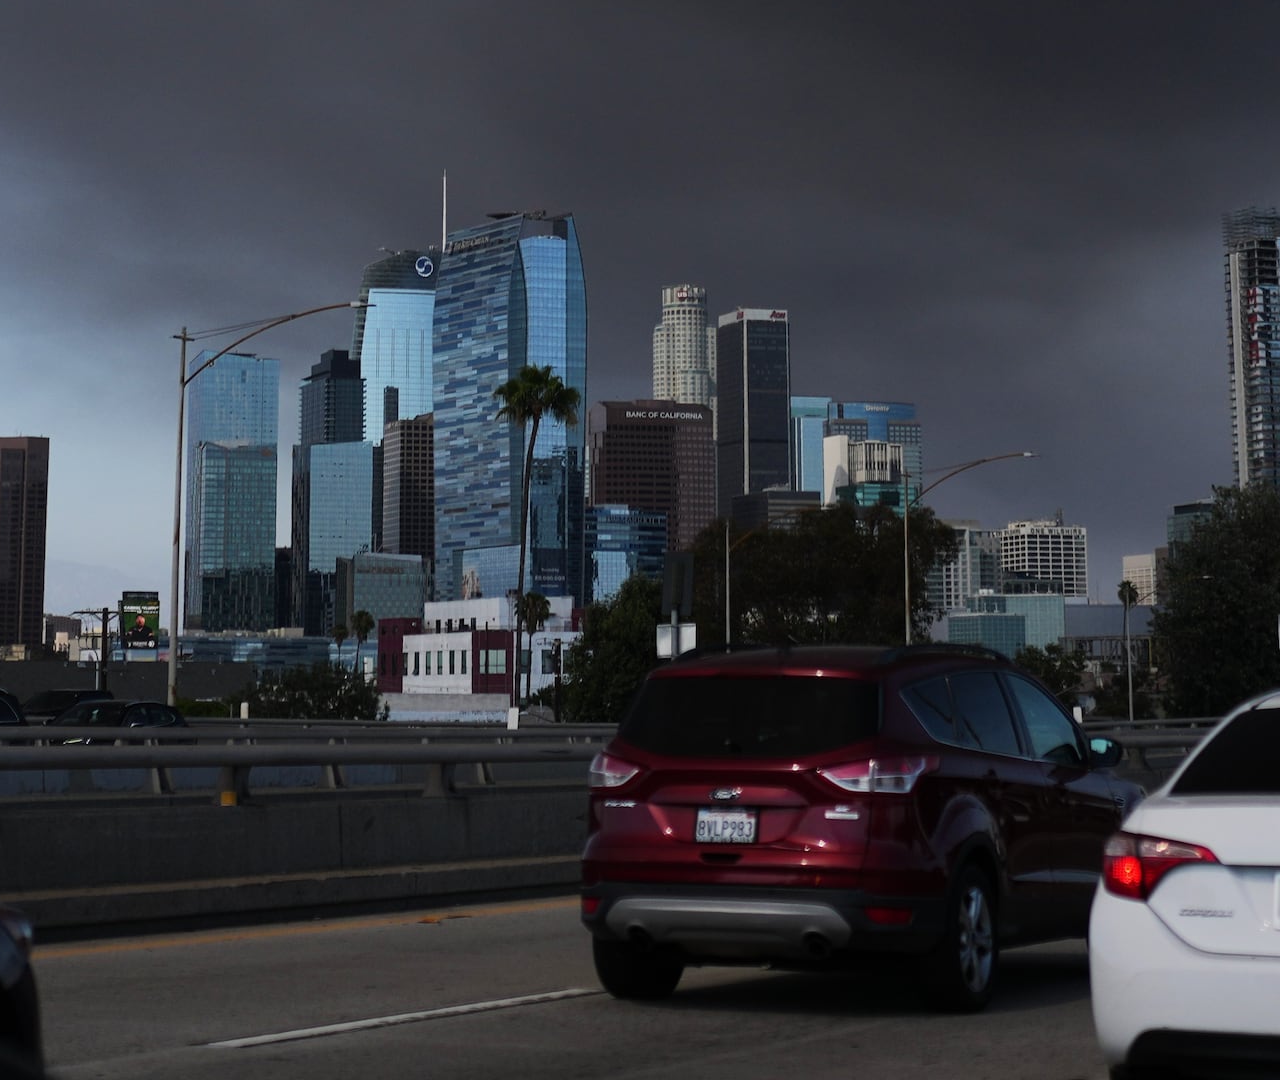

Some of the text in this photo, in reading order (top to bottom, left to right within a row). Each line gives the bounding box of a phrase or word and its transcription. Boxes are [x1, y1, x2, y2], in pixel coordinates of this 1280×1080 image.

[625, 411, 647, 419] BANC
[648, 411, 659, 419] OF
[1048, 528, 1082, 536] WILSHIRE
[697, 820, 753, 838] 8VLP983
